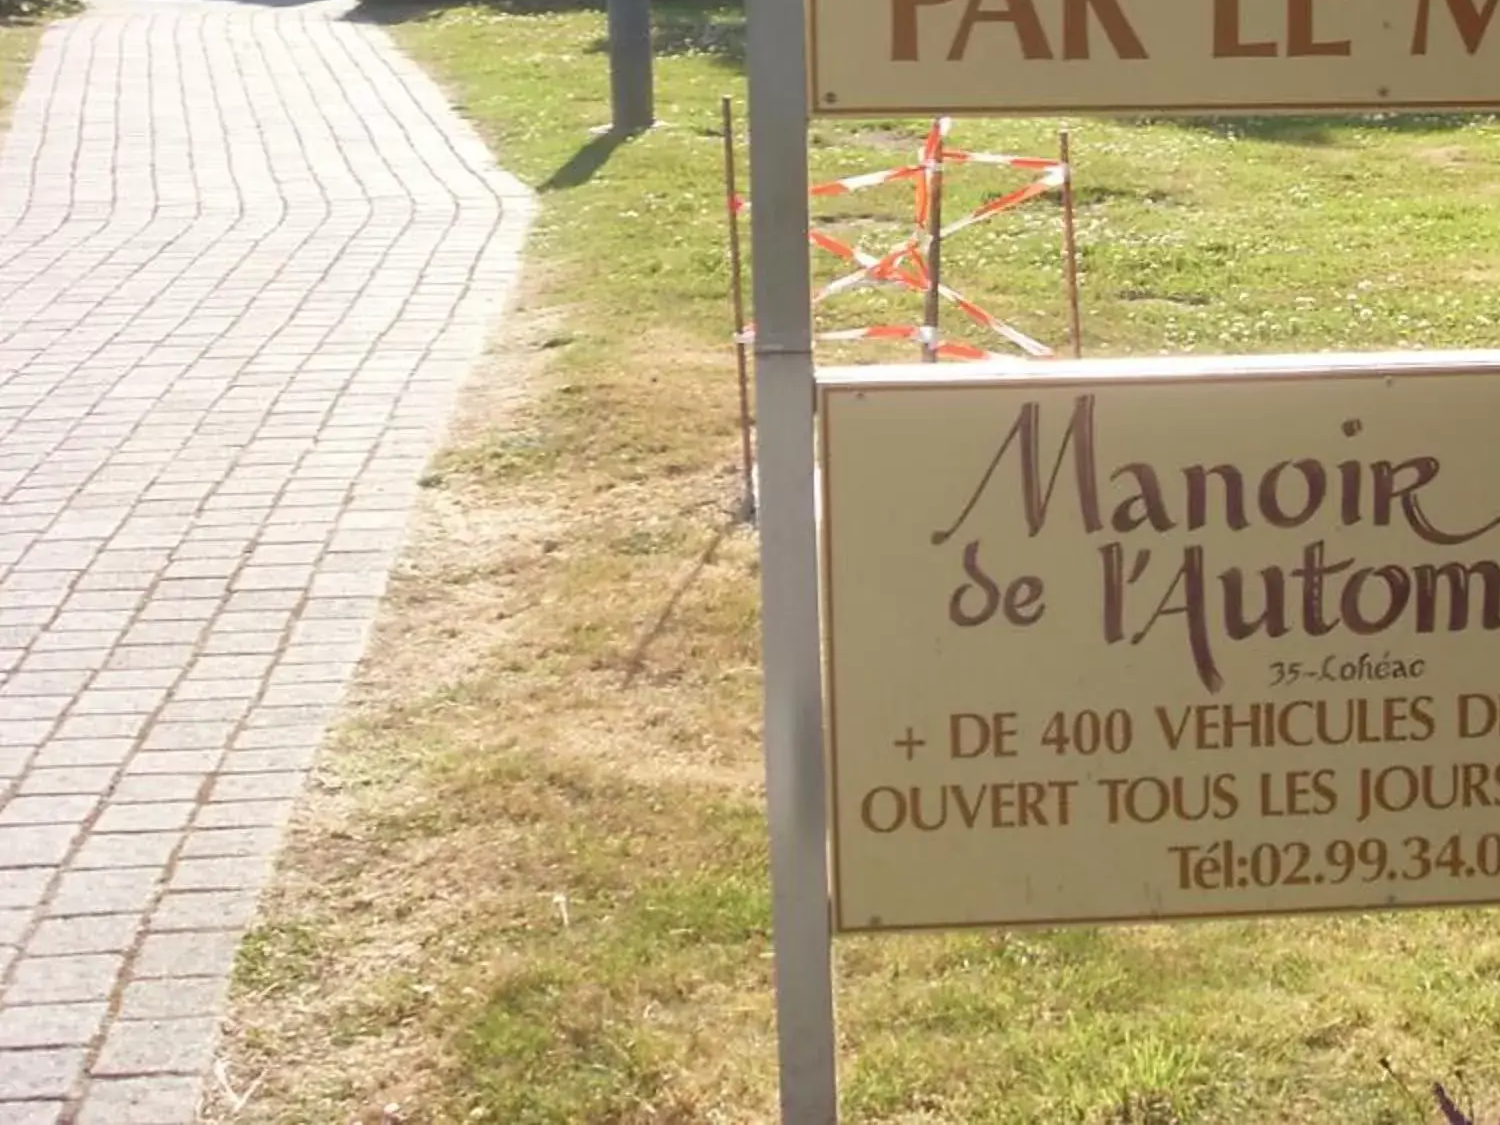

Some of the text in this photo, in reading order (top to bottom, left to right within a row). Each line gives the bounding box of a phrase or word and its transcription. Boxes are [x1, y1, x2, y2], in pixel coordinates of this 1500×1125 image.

[949, 539, 1046, 628] de
[893, 727, 926, 761] +
[950, 712, 1018, 760] DE
[1041, 709, 1133, 756] 400
[1155, 696, 1436, 751] VEHICULES
[860, 779, 1079, 832] OUVERT
[1097, 773, 1239, 824] TOUS
[1261, 768, 1338, 817] LES
